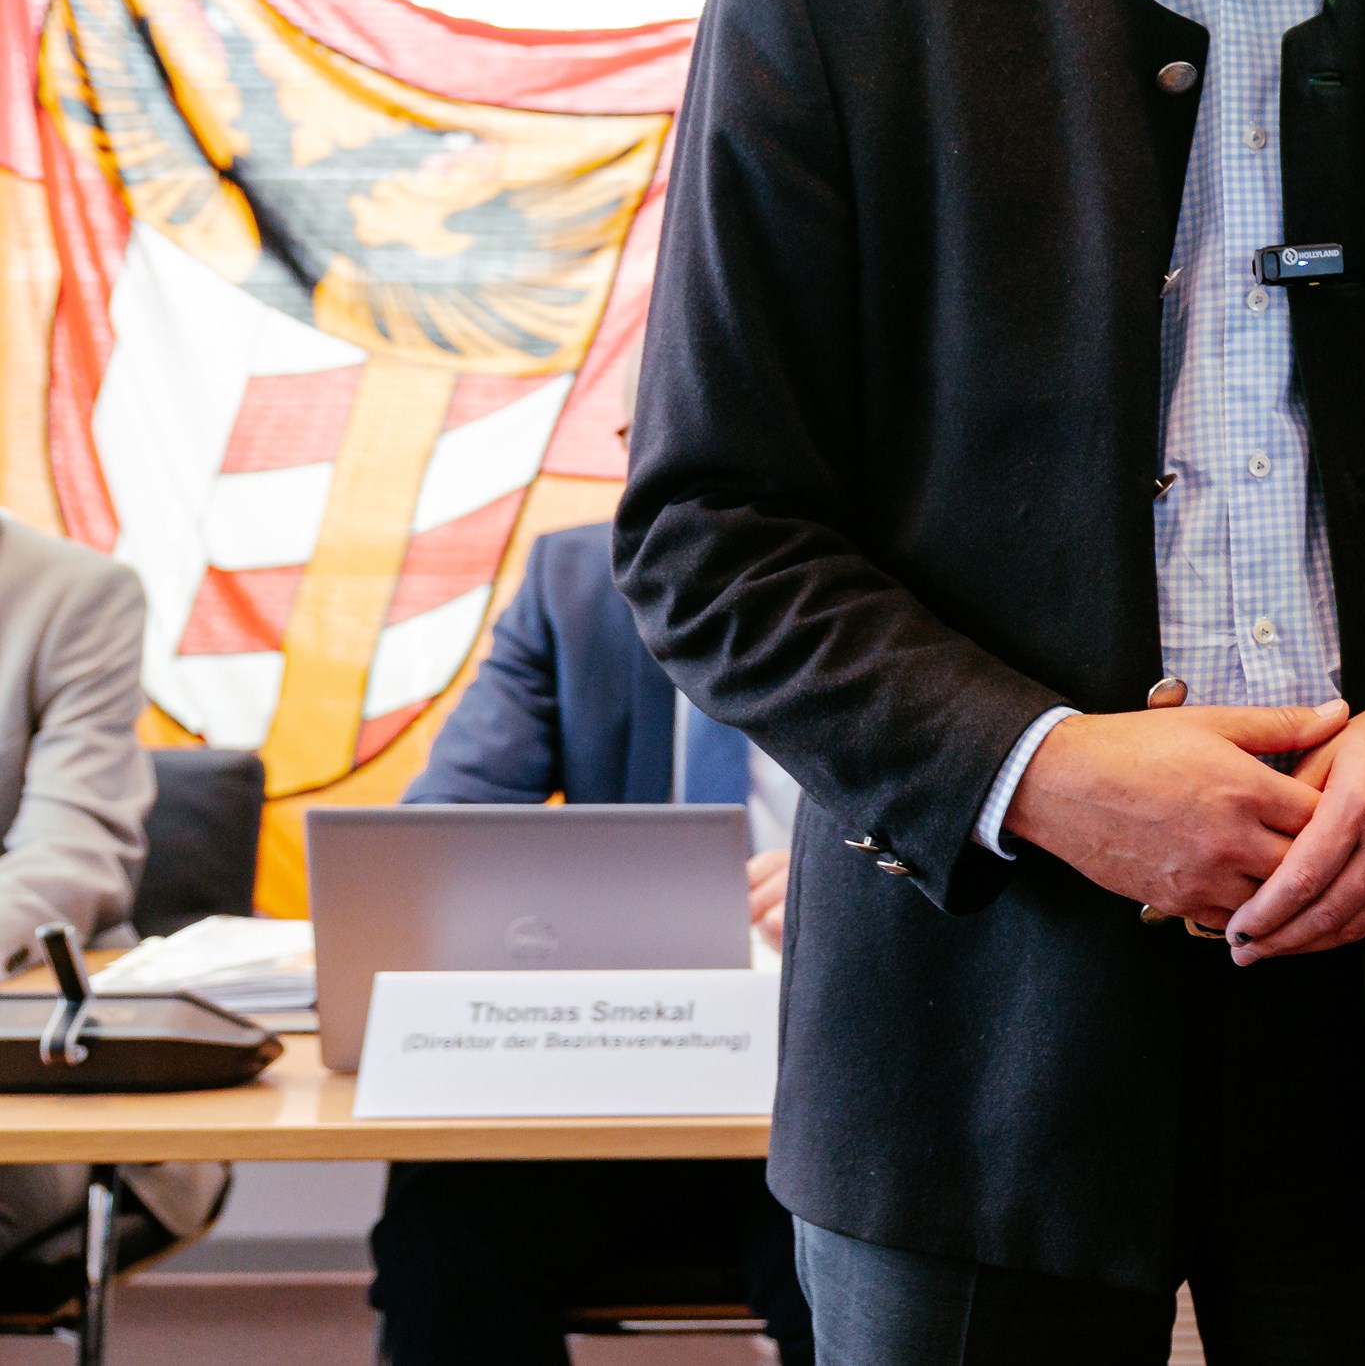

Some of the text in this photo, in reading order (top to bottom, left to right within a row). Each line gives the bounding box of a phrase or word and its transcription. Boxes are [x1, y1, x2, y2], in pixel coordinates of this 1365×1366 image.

[1298, 249, 1340, 259] HOLLYLAND
[468, 1000, 695, 1023] Thomas Smekal
[401, 1032, 750, 1054] (Direktor der Bezirksverwaltung)
